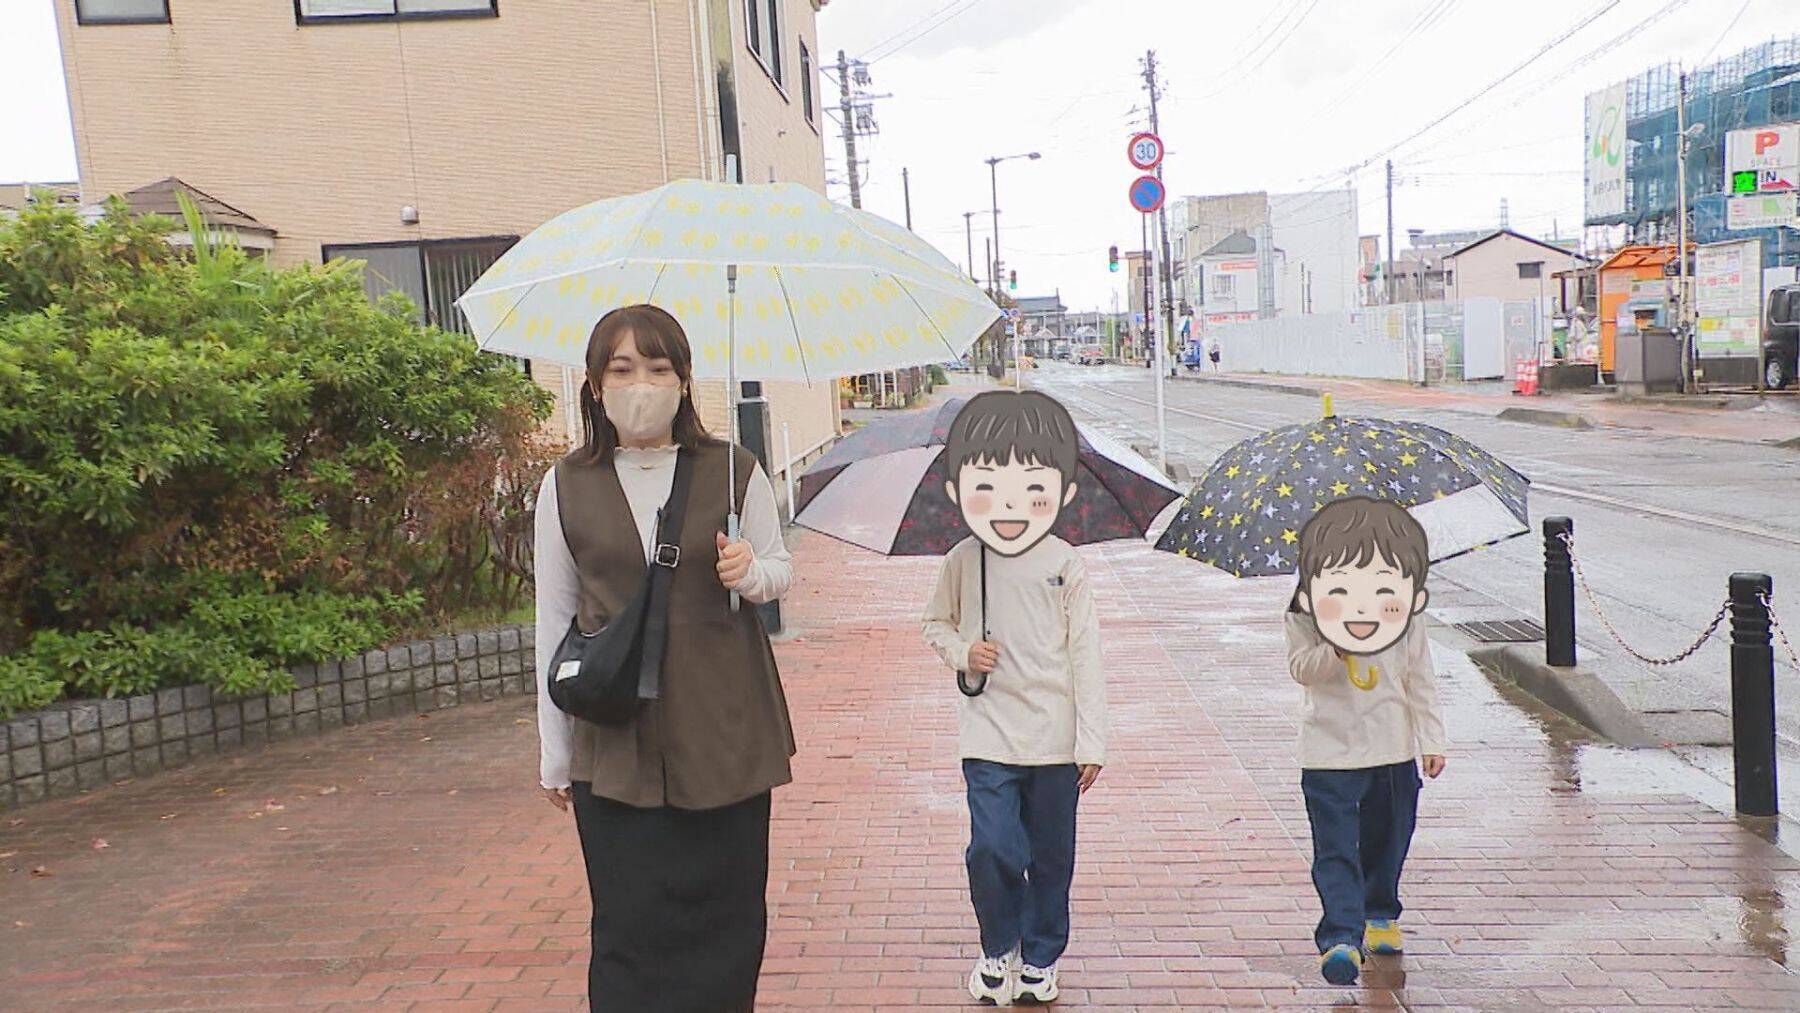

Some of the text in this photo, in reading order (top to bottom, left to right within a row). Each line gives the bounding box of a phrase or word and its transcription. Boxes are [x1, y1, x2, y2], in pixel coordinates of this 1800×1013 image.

[1136, 142, 1156, 160] 30
[1755, 131, 1780, 155] P
[1761, 170, 1776, 182] IN
